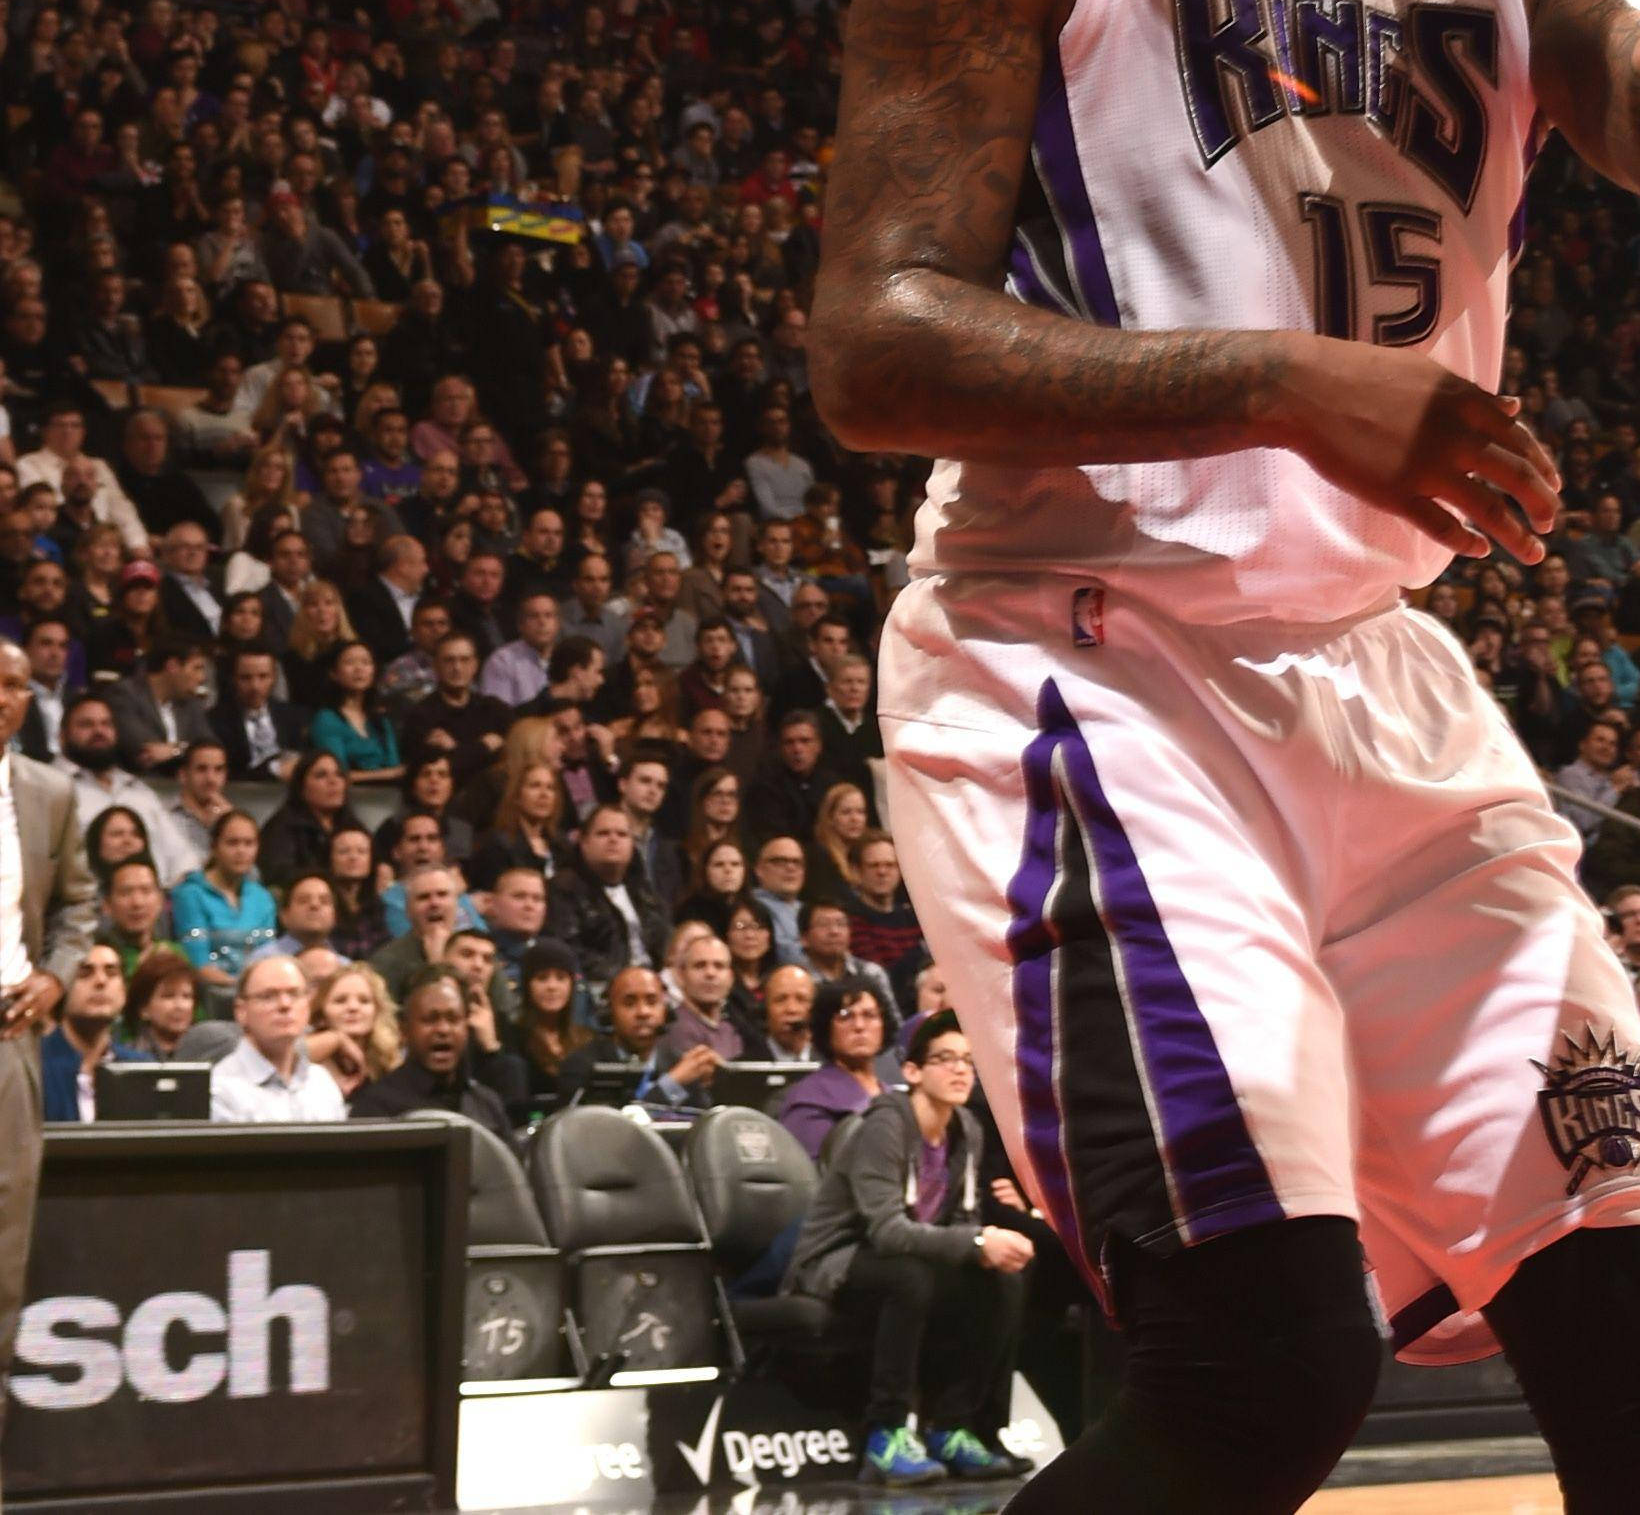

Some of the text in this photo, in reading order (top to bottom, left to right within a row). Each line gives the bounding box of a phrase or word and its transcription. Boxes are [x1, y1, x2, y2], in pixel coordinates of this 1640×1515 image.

[1300, 192, 1442, 346] 15
[8, 1248, 331, 1410] sch
[723, 1428, 853, 1478] Degree
